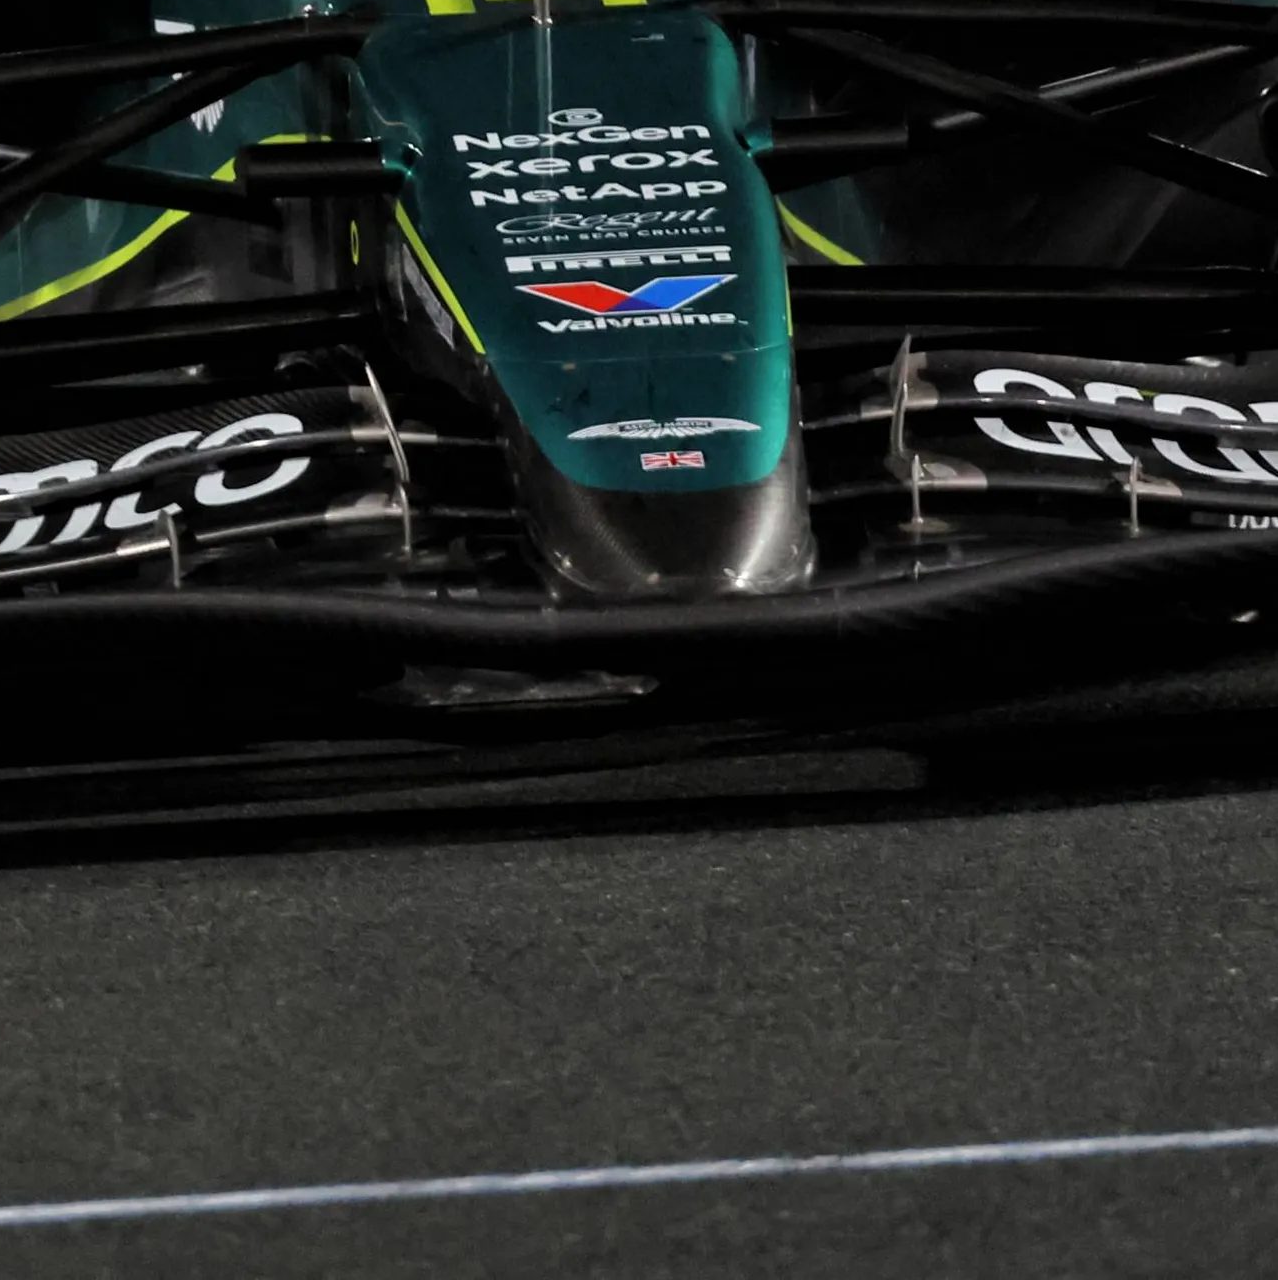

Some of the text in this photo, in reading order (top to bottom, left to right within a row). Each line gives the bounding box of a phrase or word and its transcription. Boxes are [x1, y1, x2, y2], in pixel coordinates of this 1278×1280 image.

[452, 124, 711, 152] NexGen
[466, 148, 720, 179] xerox
[470, 179, 728, 207] NetApp
[503, 225, 726, 245] SEVEN SEAS CRUISES
[505, 245, 732, 273] PIRELLI
[537, 312, 737, 334] Valvoline
